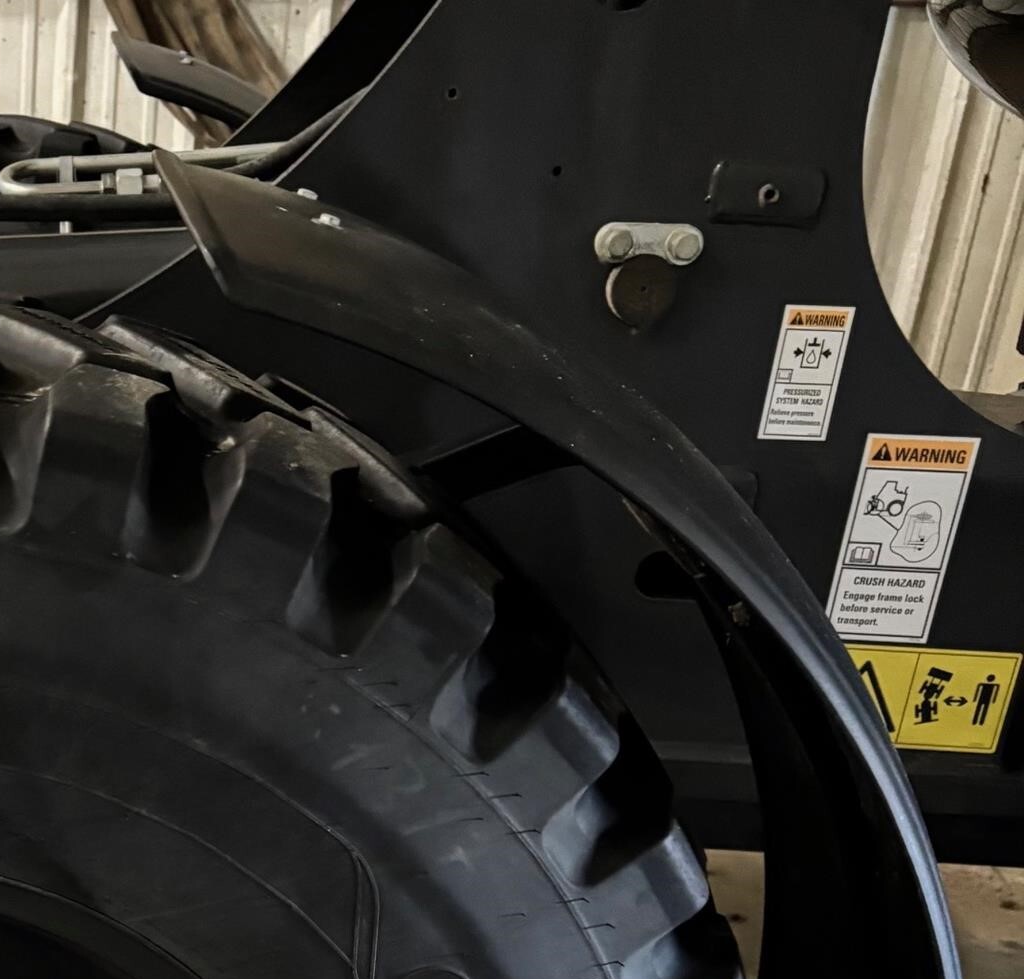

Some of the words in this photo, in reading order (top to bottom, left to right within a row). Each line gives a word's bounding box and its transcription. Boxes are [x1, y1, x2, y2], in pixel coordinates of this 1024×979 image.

[805, 315, 846, 328] WARNING
[895, 447, 968, 464] WARNING
[853, 576, 885, 587] CRUSH
[887, 578, 926, 589] HAZARD
[843, 590, 876, 602] Engage
[877, 592, 903, 602] frame
[904, 594, 925, 603] lock
[840, 603, 869, 613] before
[870, 605, 903, 615] service
[837, 617, 879, 627] transport.
